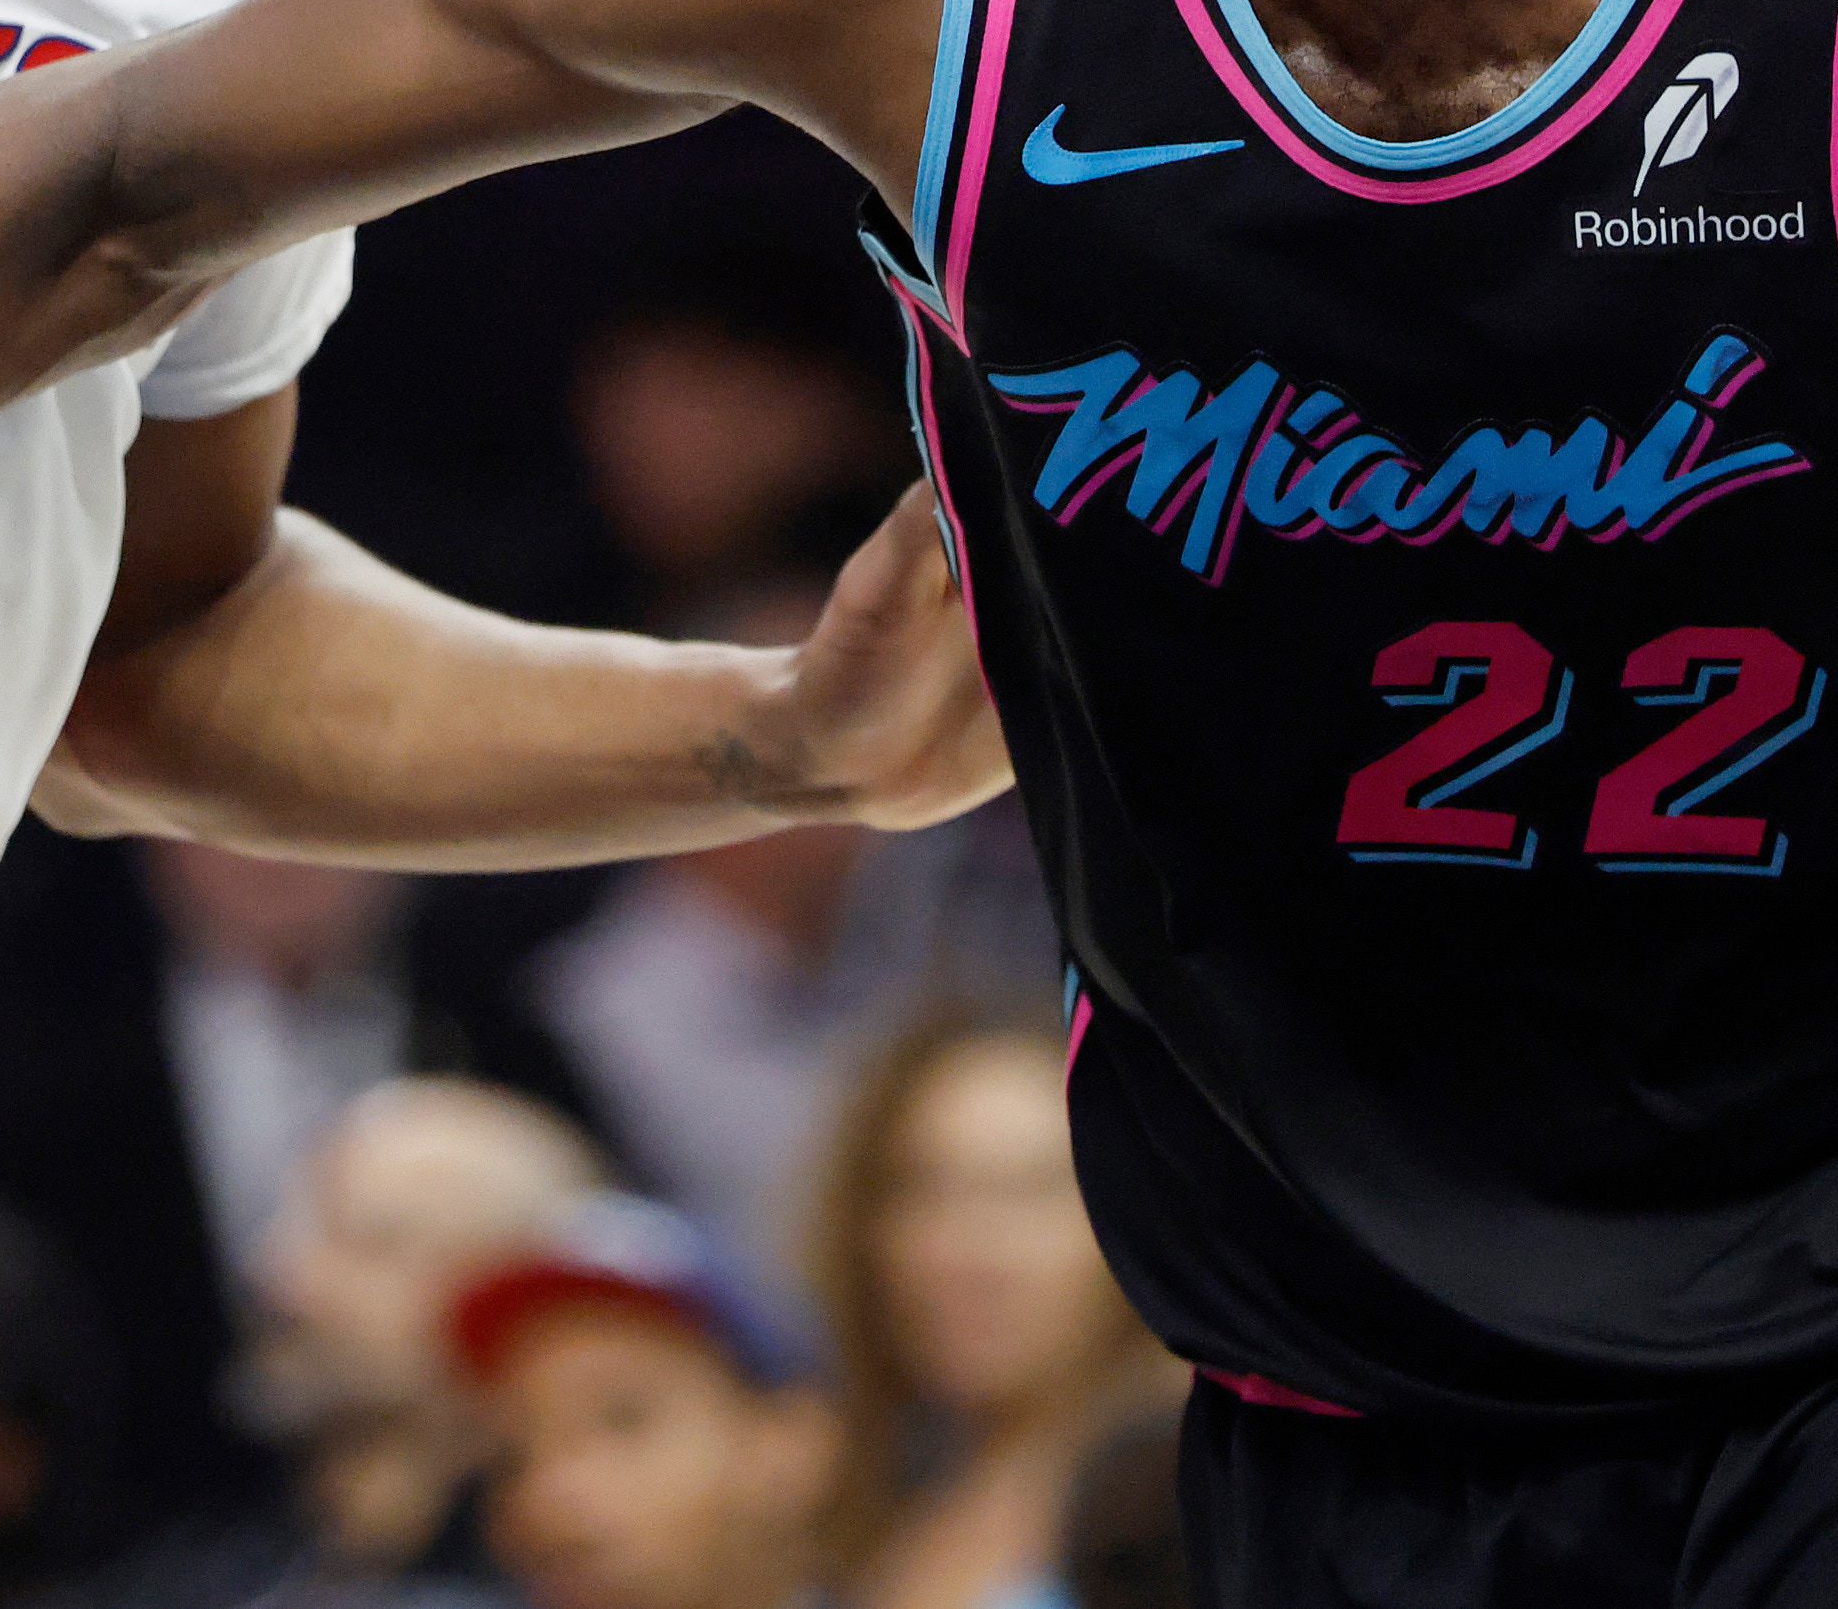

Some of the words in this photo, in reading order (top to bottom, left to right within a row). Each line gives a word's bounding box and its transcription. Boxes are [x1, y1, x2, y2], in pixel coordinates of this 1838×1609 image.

[1573, 201, 1806, 248] Robinhood
[987, 334, 1812, 587] Miami
[1335, 621, 1827, 877] 22
